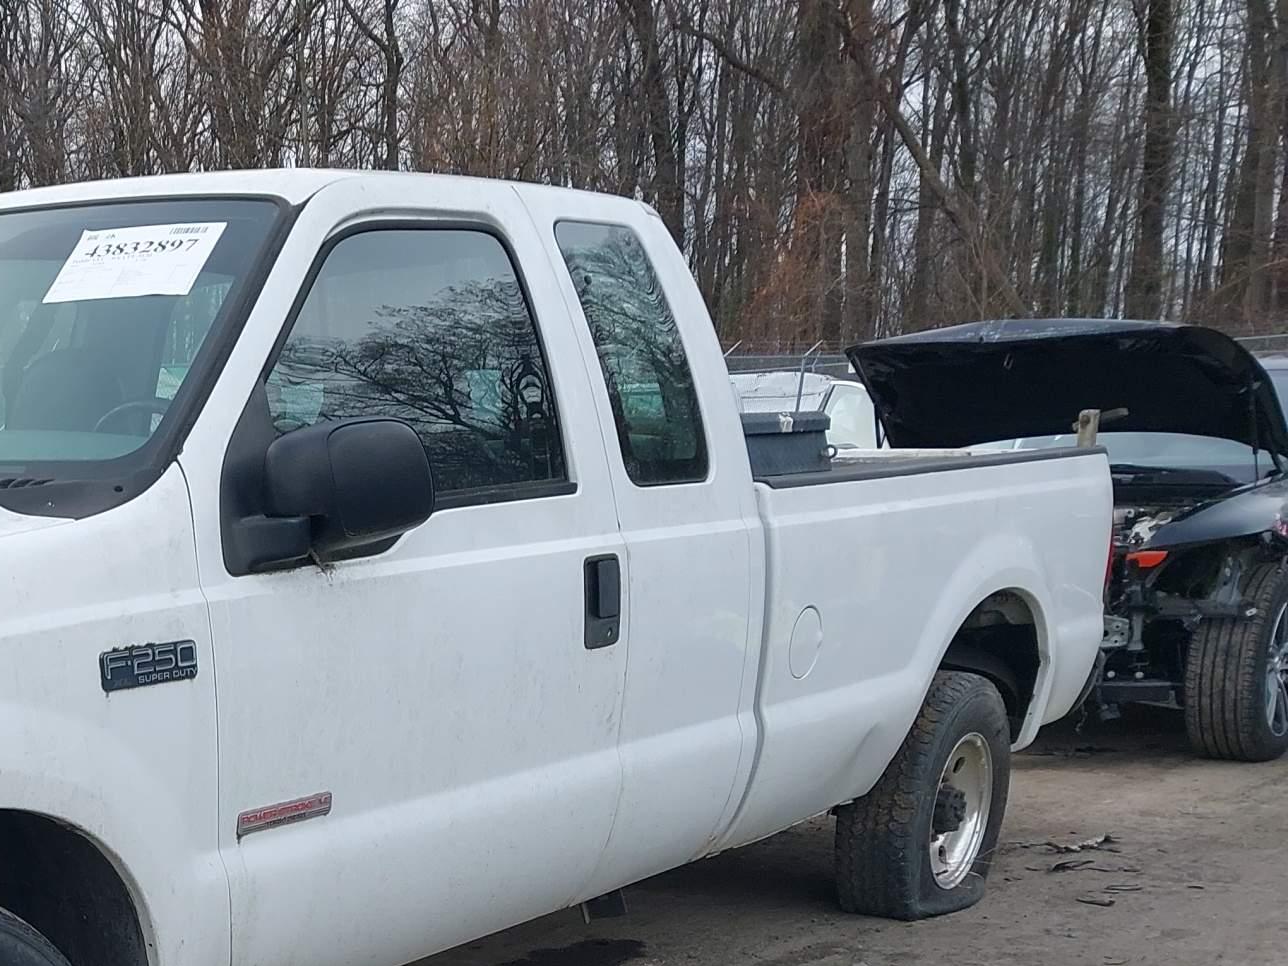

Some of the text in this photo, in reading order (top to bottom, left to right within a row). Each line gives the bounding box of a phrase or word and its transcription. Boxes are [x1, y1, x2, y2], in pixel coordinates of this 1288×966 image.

[84, 238, 200, 258] 43832897
[138, 667, 197, 684] SUPER DUTY
[278, 799, 317, 817] STROK
